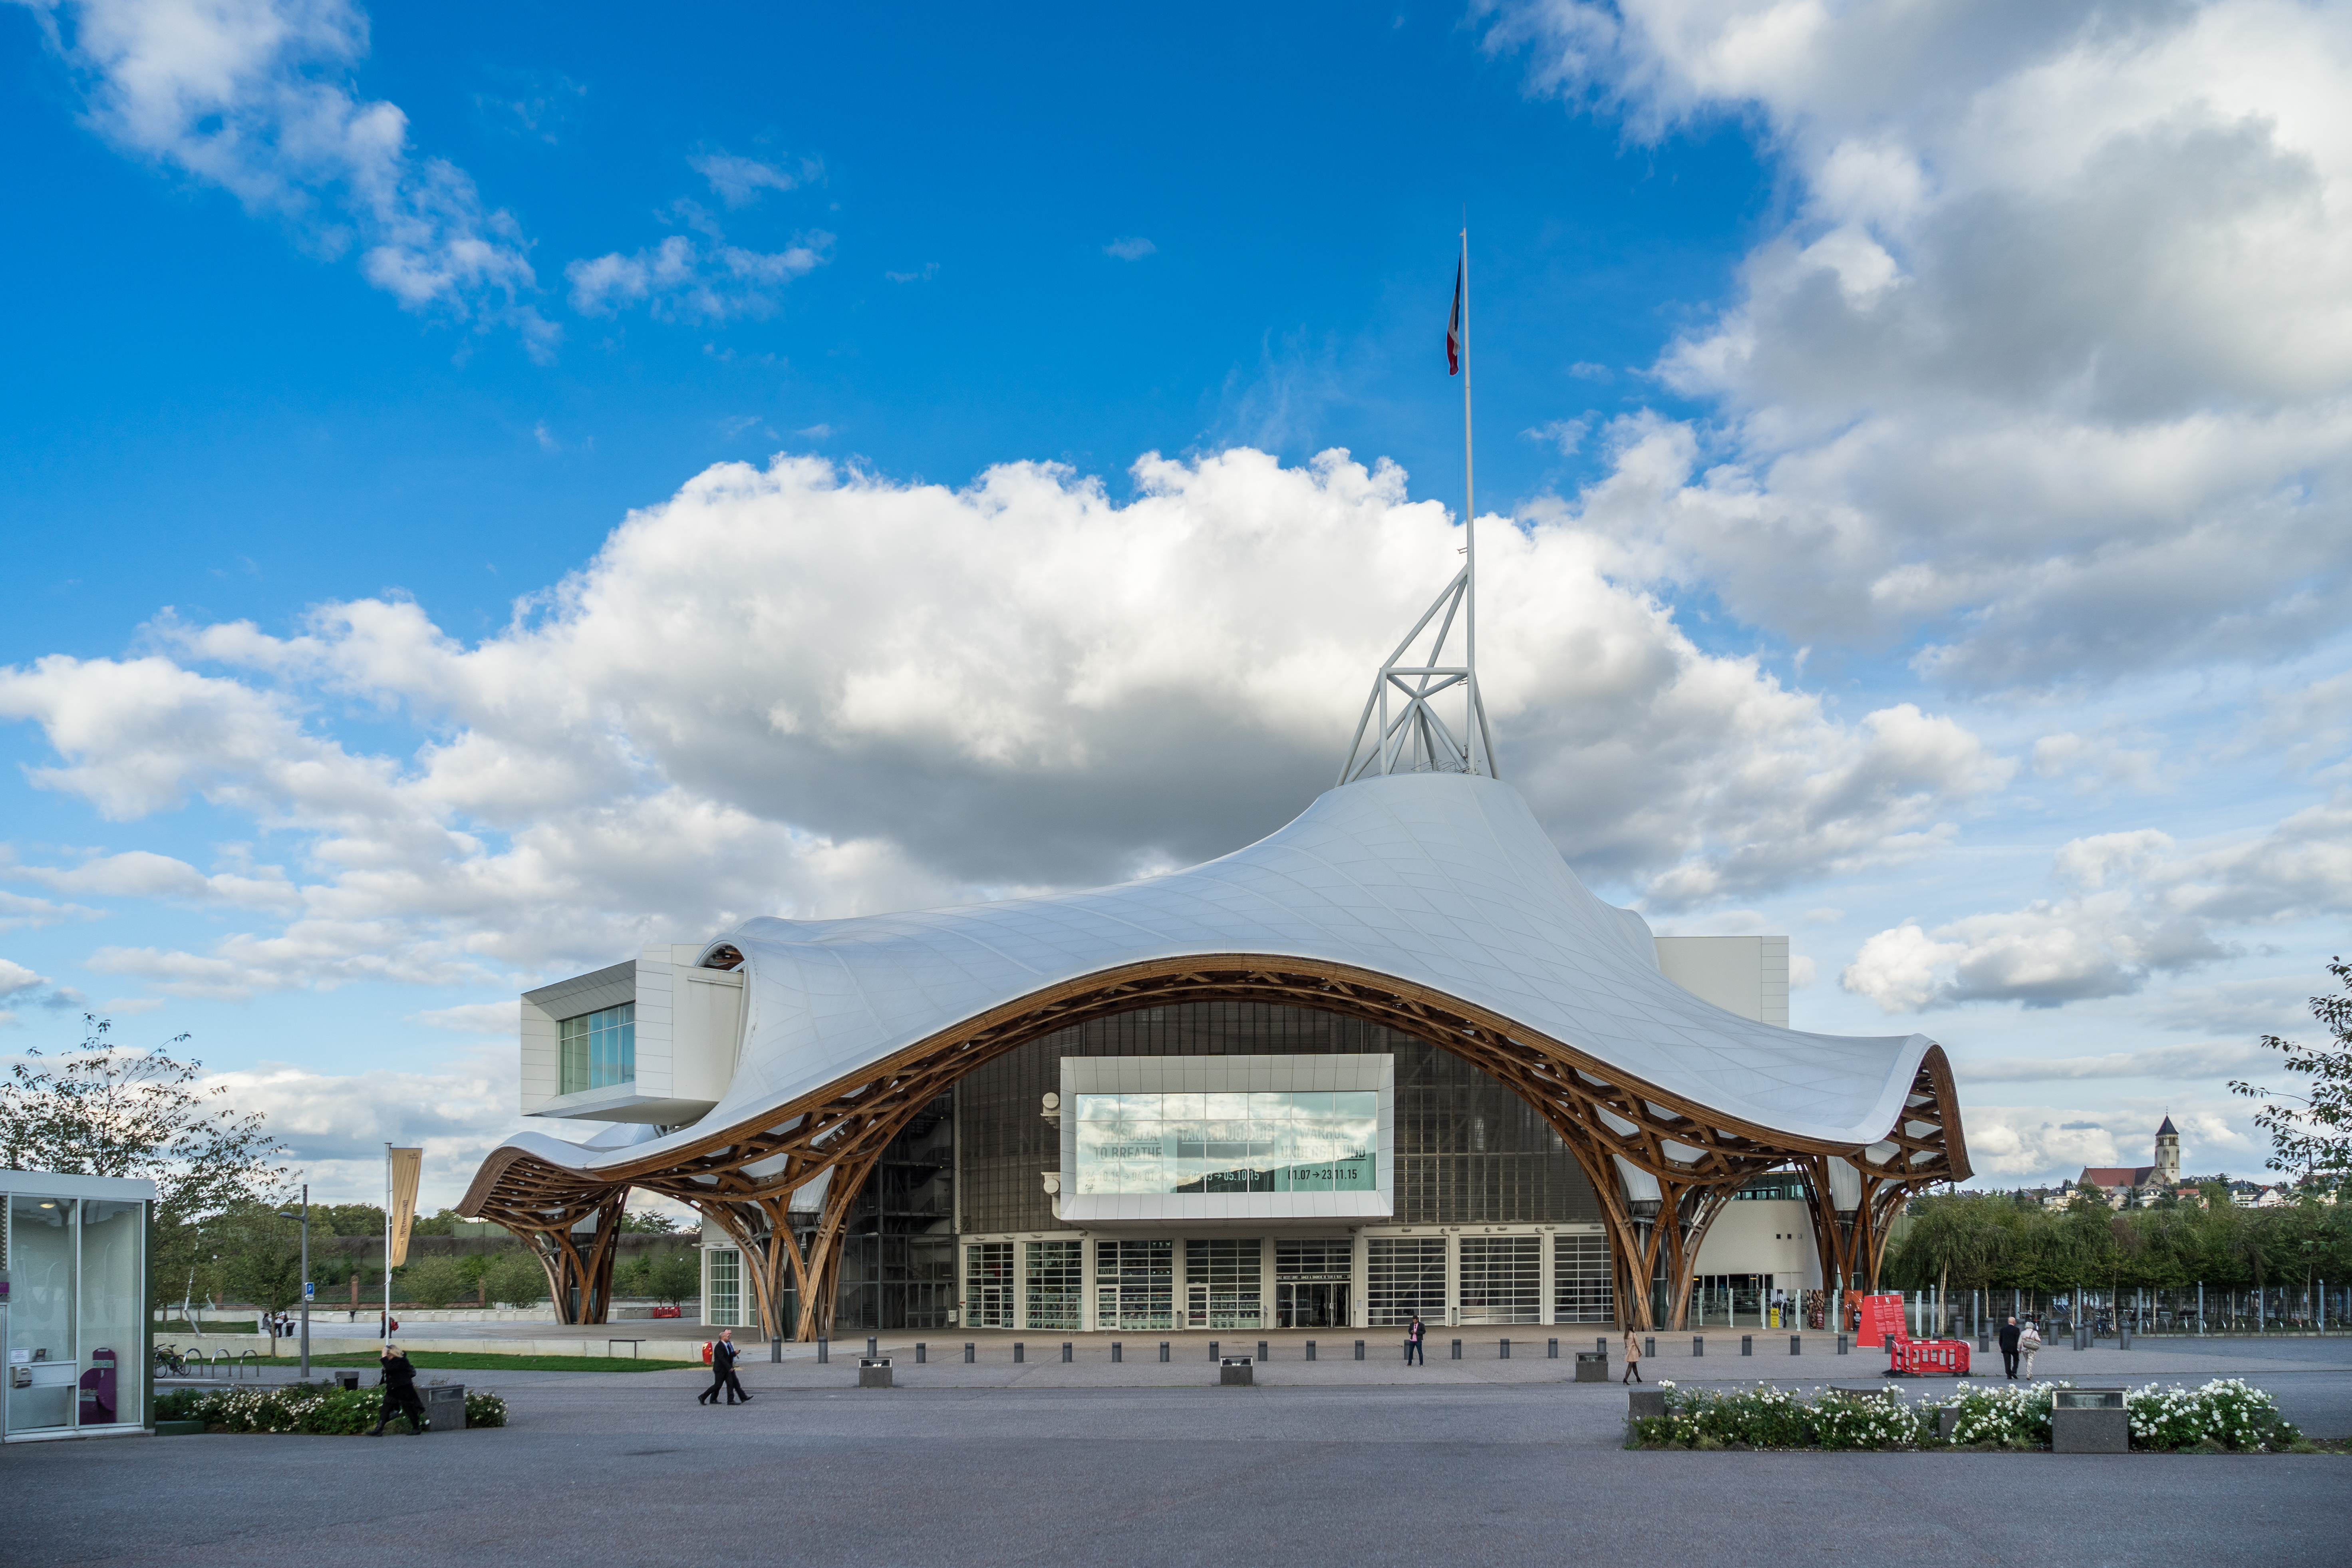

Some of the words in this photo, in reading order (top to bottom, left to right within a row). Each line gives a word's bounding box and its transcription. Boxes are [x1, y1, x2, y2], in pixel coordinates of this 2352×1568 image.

[1099, 1128, 1158, 1141] KIMSOOJA
[1180, 1127, 1213, 1141] TANIA
[1217, 1127, 1272, 1141] MOURAUD
[1300, 1126, 1348, 1139] WARHOL
[1094, 1147, 1107, 1160] TO
[1112, 1147, 1162, 1160] BREATHE
[1281, 1145, 1366, 1158] UNDERGROUND
[1190, 1171, 1213, 1180] 04.03
[1224, 1170, 1259, 1180] 05.1015
[1288, 1169, 1311, 1180] 01.07
[1322, 1169, 1357, 1179] 23.11.15
